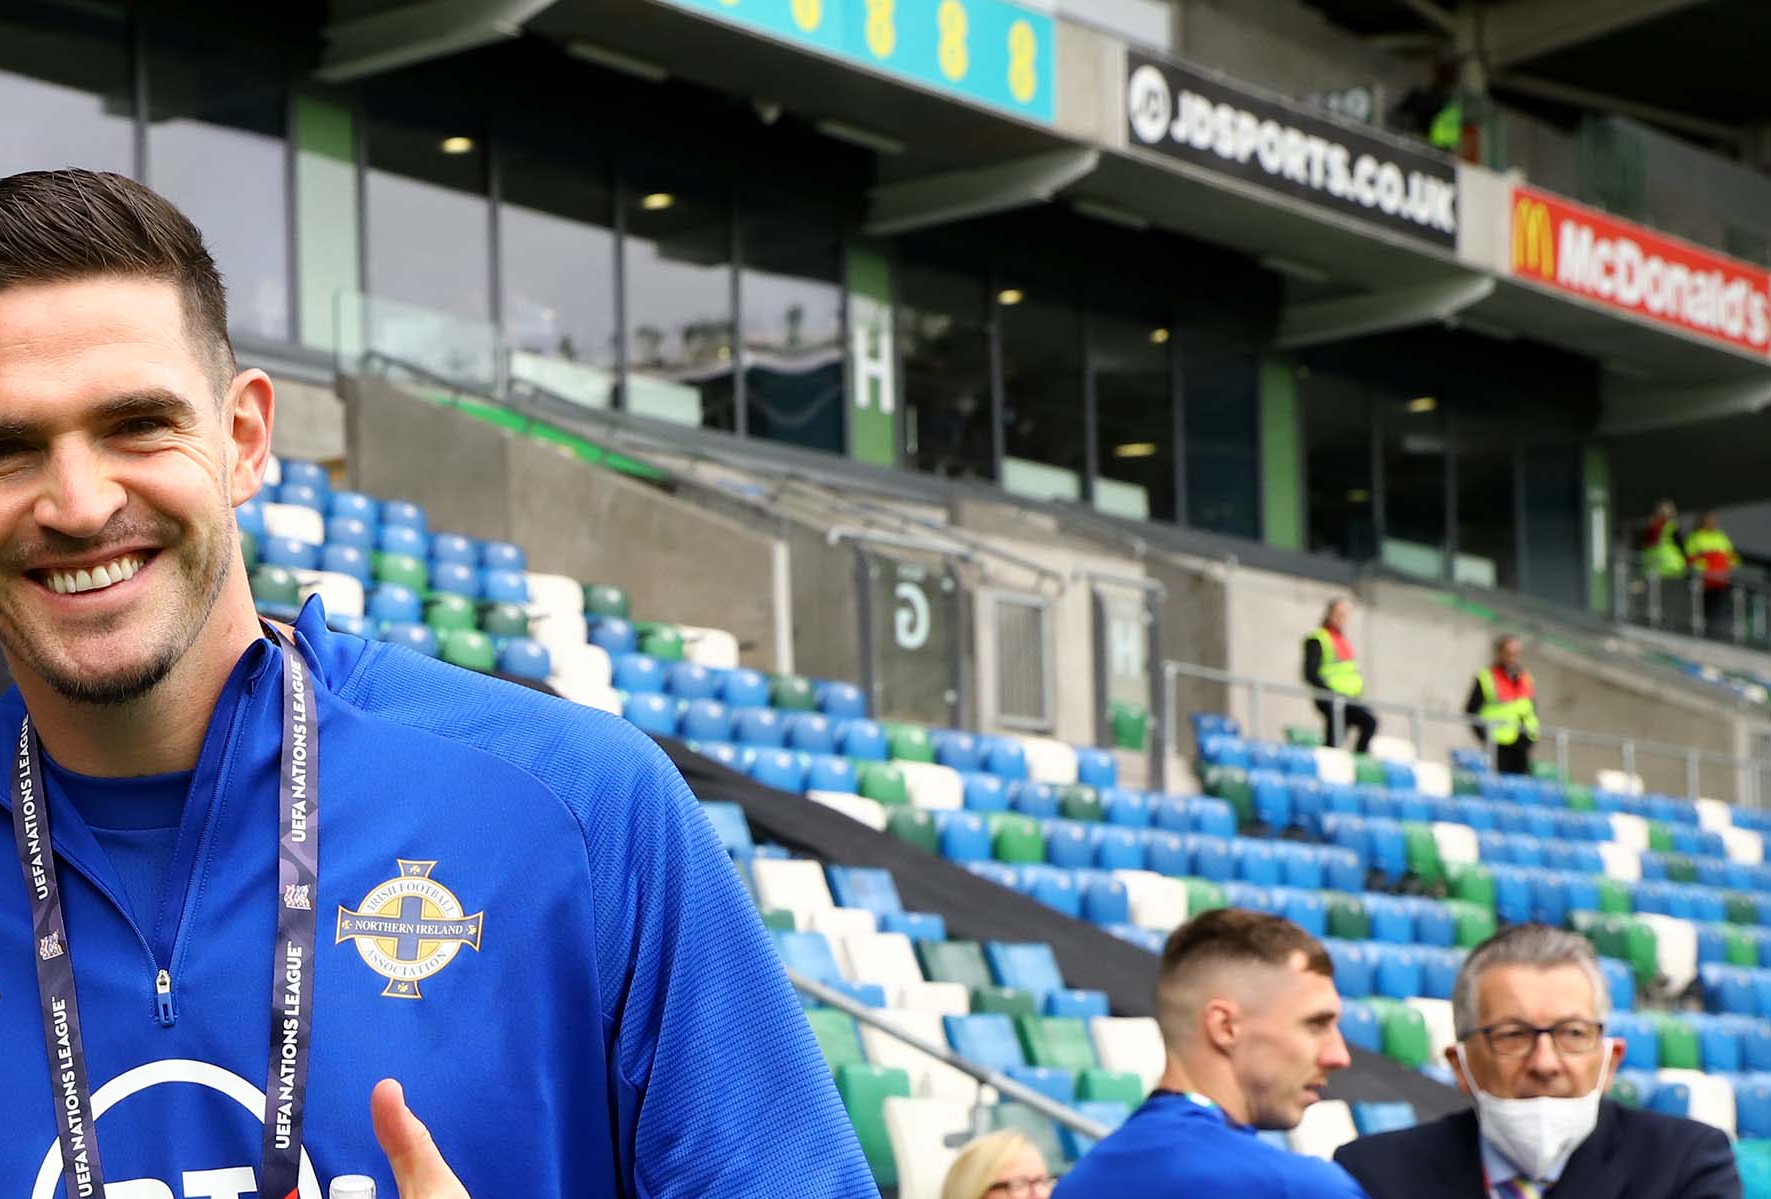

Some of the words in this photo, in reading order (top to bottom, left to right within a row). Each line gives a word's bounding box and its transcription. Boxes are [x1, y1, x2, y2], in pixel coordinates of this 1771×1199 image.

[1170, 90, 1455, 234] JDSPORTS.CO.UK
[1557, 219, 1767, 346] McDonald's
[289, 657, 307, 723] LEAGUE
[291, 723, 307, 798] NATIONS
[20, 780, 41, 856] NATIONS
[291, 800, 307, 843] UEFA
[32, 854, 49, 900] UEFA
[366, 884, 397, 911] IRISH
[399, 881, 456, 915] FOOTBALL
[354, 920, 414, 934] NORTHERN
[416, 923, 463, 935] IRELAND
[284, 945, 303, 1016] LEAGUE
[365, 949, 448, 977] ASSOCIATION
[51, 999, 74, 1071] LEAGUE
[278, 1018, 299, 1101] NATIONS
[61, 1071, 85, 1154] NATIONS
[275, 1102, 293, 1149] UEFA
[74, 1150, 94, 1198] UEFA
